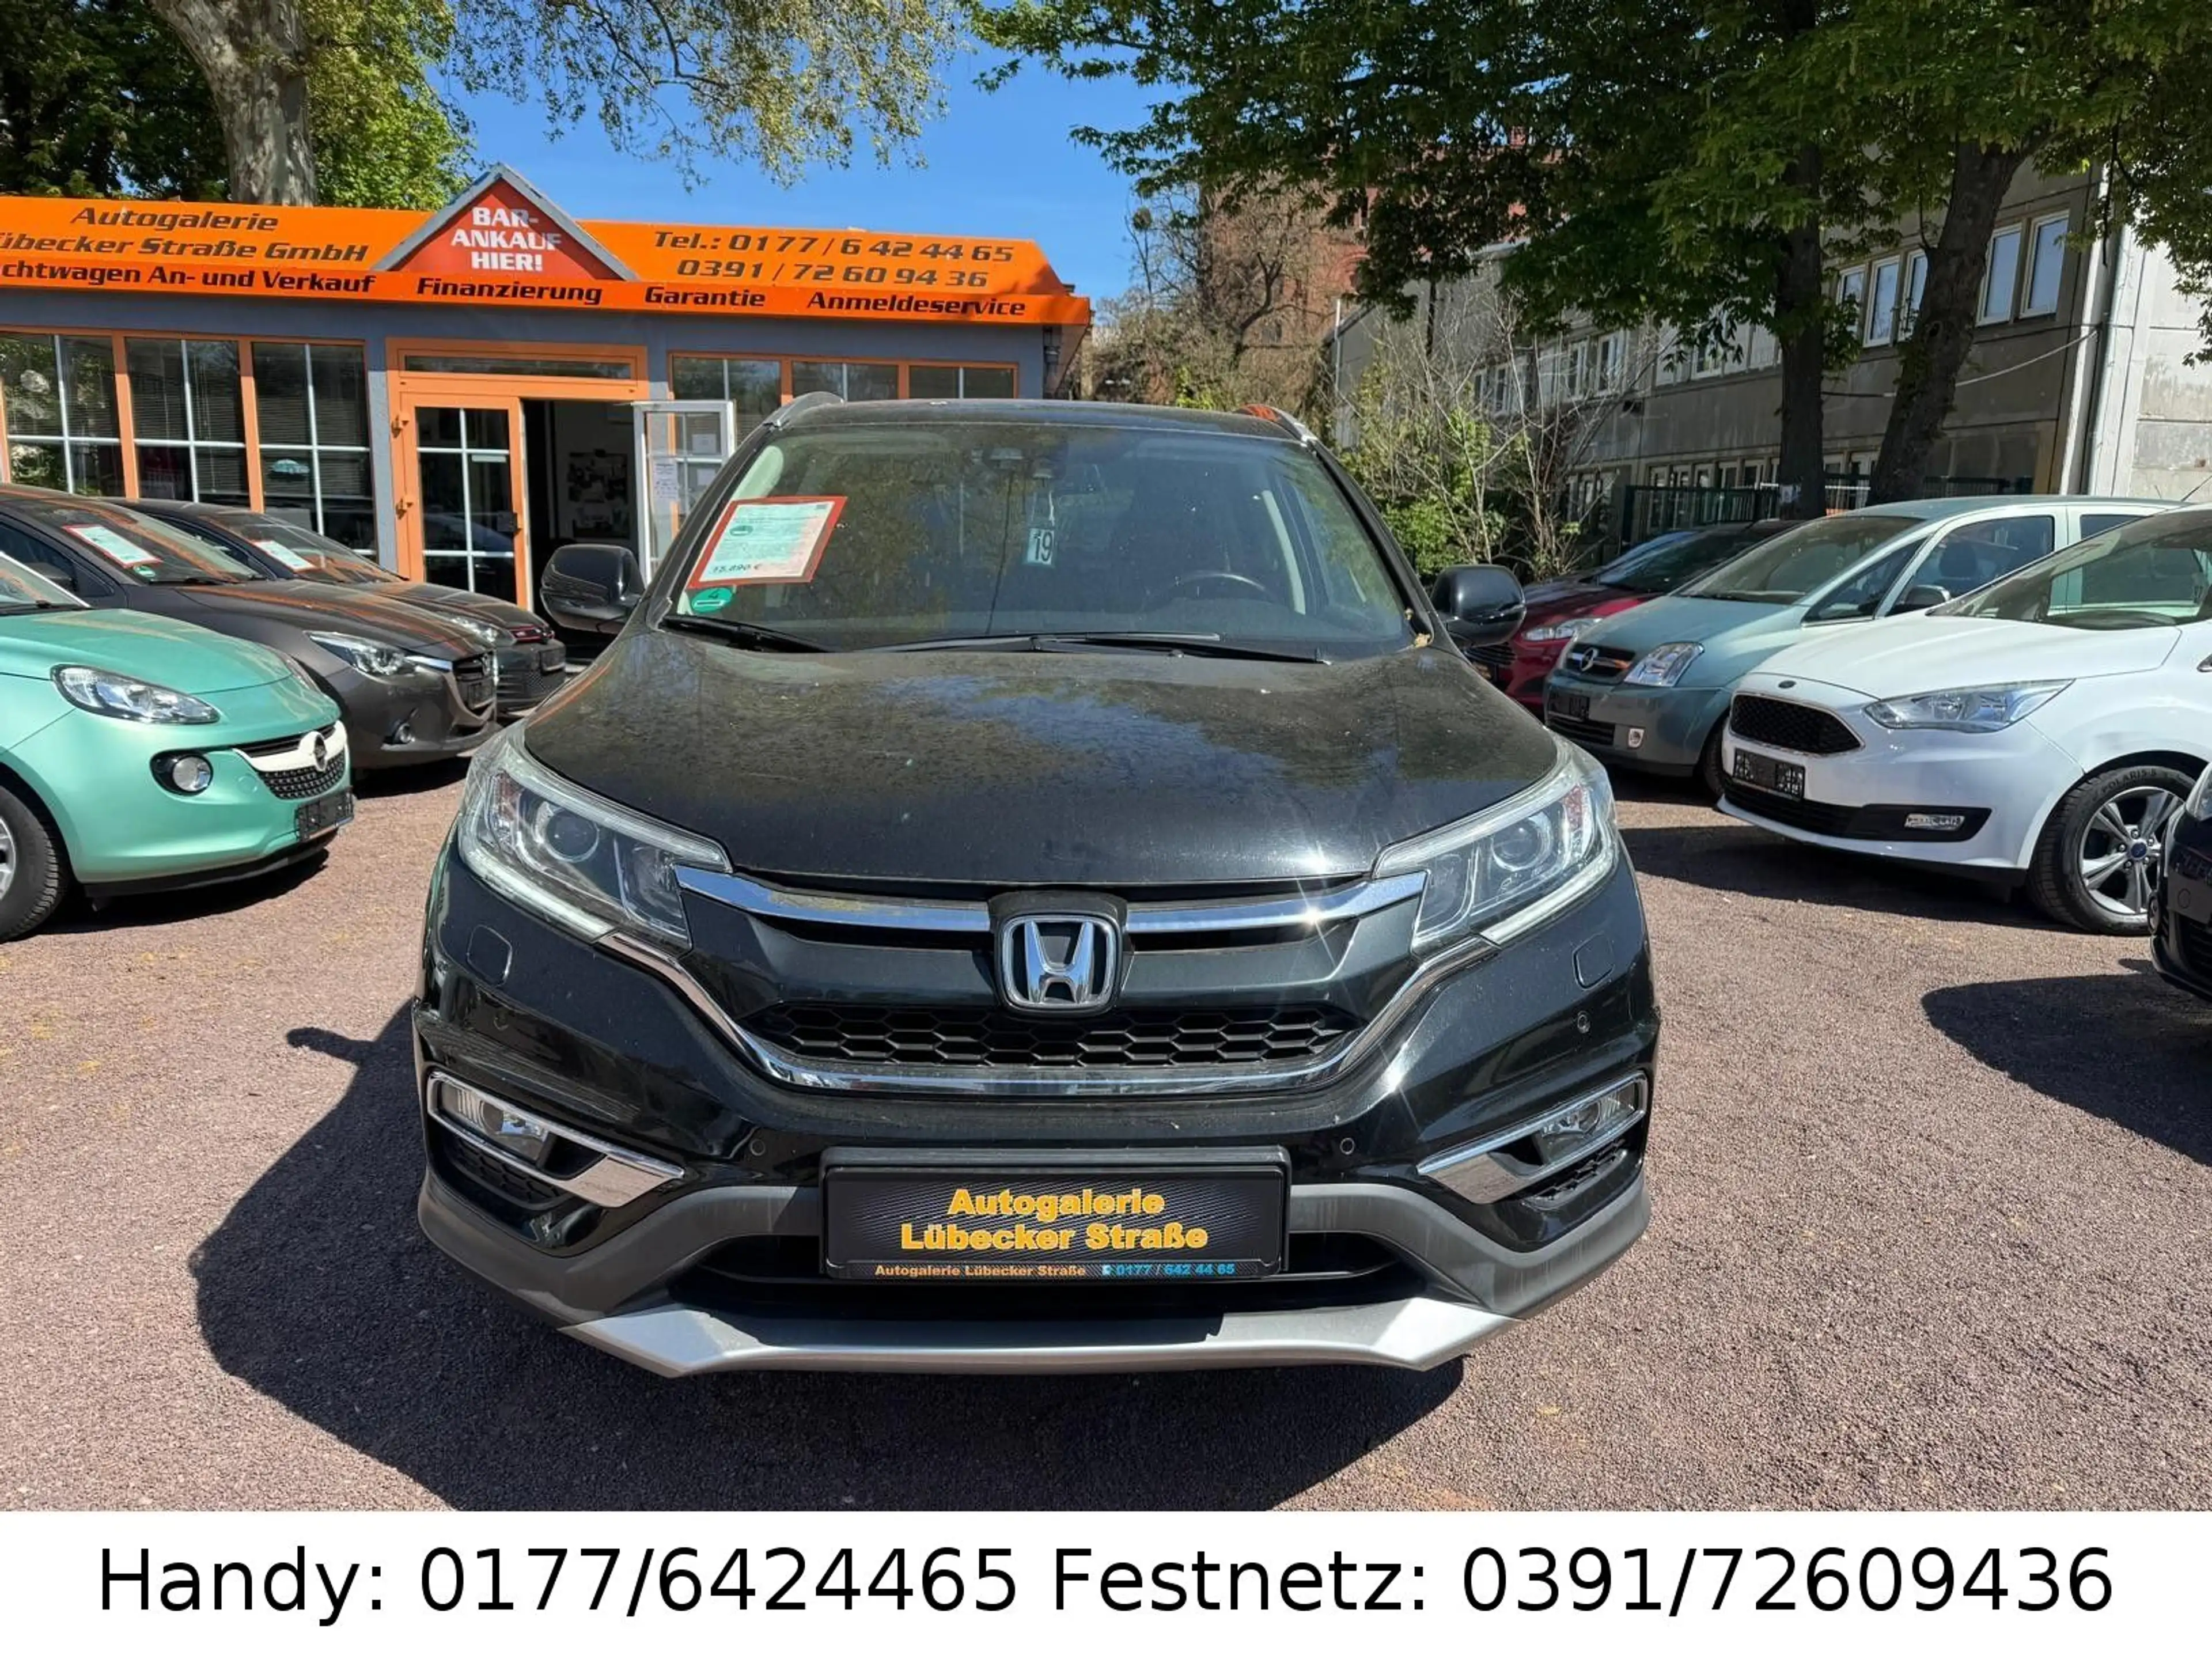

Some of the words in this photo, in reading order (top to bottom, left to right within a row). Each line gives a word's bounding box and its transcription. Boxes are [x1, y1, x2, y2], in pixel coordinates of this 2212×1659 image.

[70, 207, 278, 231] Autogalerie
[472, 207, 539, 227] BAR-
[137, 238, 257, 258] Straße
[265, 243, 369, 262] GmbH
[450, 229, 562, 250] ANKAUF
[656, 232, 721, 249] Tel.:
[868, 240, 913, 257] 42
[919, 243, 964, 259] 44
[971, 245, 1014, 262] 65
[471, 251, 542, 271] HIER!
[677, 259, 763, 278] 0391
[793, 264, 835, 281] 72
[843, 266, 887, 283] 60
[894, 268, 938, 285] 94
[945, 271, 990, 287] 36
[2, 260, 140, 285] chtwagen
[148, 266, 196, 285] An-
[202, 270, 255, 287] und
[262, 270, 377, 293] Verkauf
[417, 278, 603, 305] Finanzierung
[645, 286, 766, 306] Garantie
[807, 292, 1025, 316] Anmeldeservice
[948, 1188, 1165, 1221] Autogalerie
[901, 1224, 1075, 1249] Lübecker
[1086, 1222, 1209, 1249] Straße
[874, 1264, 961, 1278] Autogalerie
[965, 1264, 1034, 1276] Lübecker
[1037, 1264, 1086, 1276] Straße
[1116, 1264, 1152, 1276] 0177
[1164, 1264, 1192, 1275] 642
[1194, 1264, 1214, 1275] 44
[1217, 1263, 1235, 1275] 65
